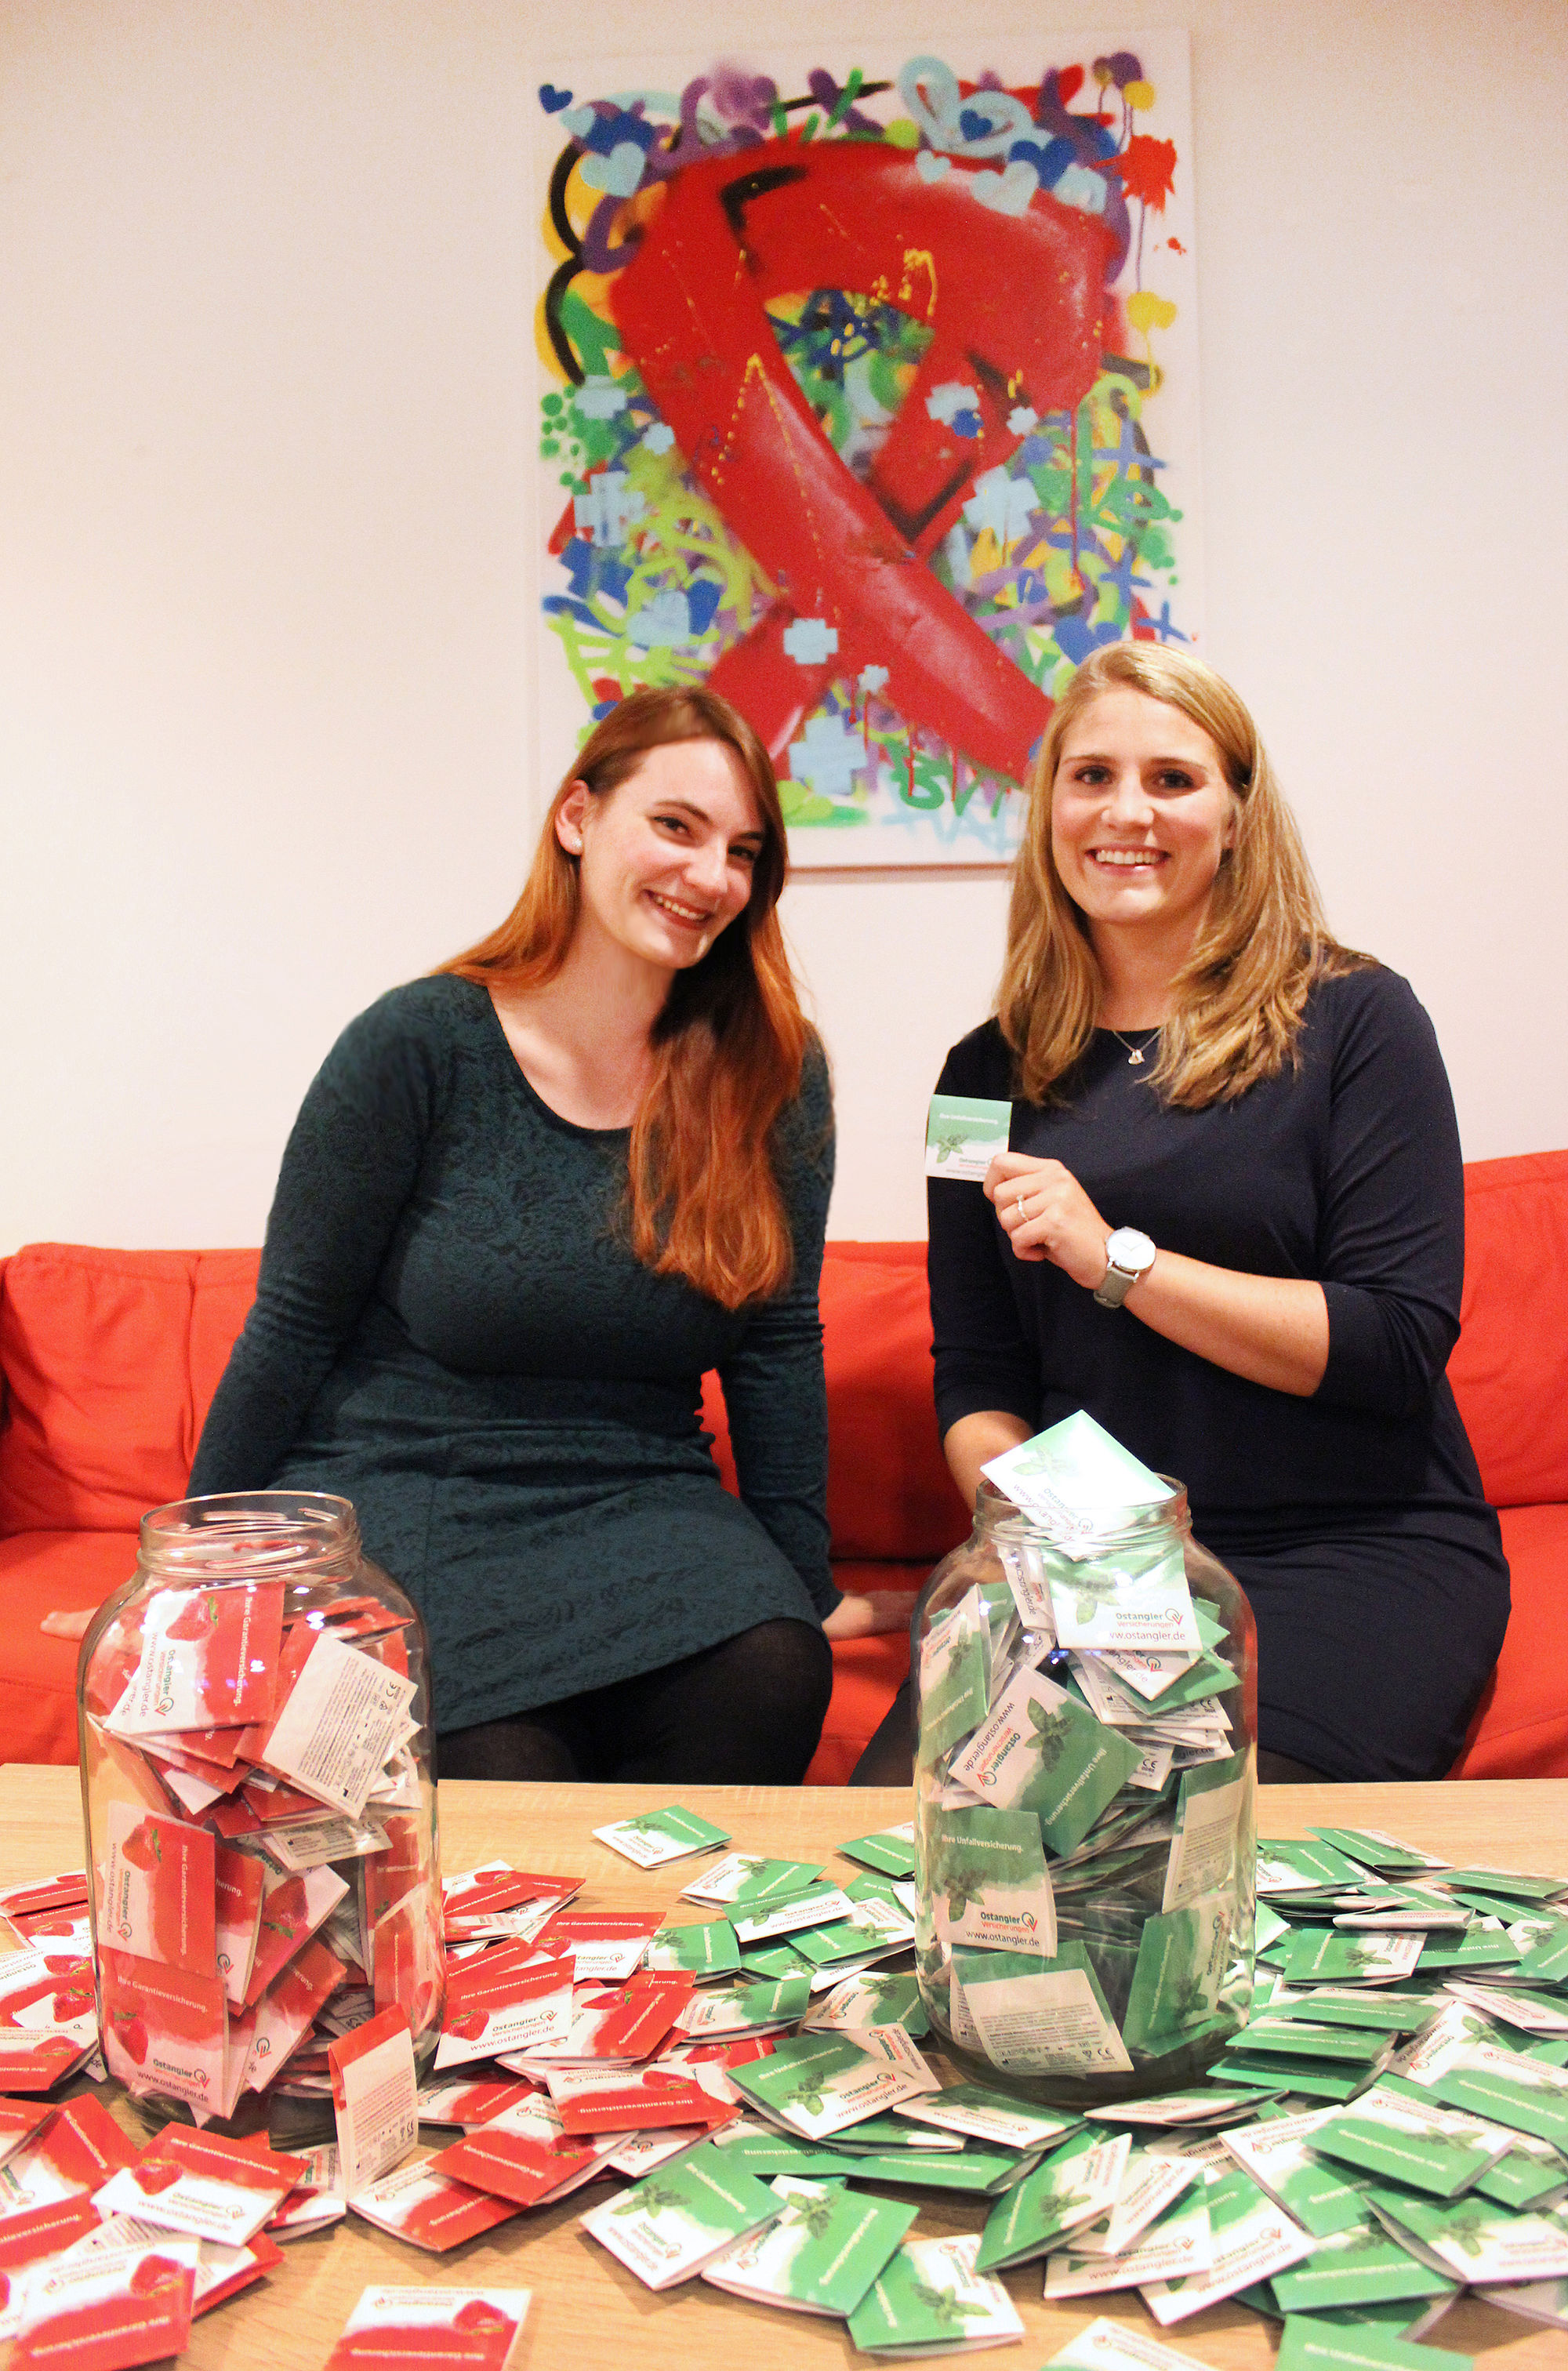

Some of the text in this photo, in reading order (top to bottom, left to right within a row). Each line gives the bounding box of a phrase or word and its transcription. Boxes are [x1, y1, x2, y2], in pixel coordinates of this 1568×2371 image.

[244, 1596, 253, 1616] Ihre
[1116, 1612, 1163, 1621] Ostangler
[965, 1702, 1016, 1771] www.ostangler.de
[991, 1732, 1021, 1773] Ostangler
[1092, 1747, 1108, 1764] Ihre
[942, 1834, 956, 1844] Ihre
[981, 1911, 1021, 1925] Ostangler
[966, 1930, 1040, 1947] www.ostangler.de
[118, 1975, 208, 2013] Ihre Garantieversicherung.
[461, 1971, 559, 2000] Ihre Garantieversicherung.
[492, 2017, 536, 2032] Ostangler
[470, 2025, 555, 2051] www.ostangler.de
[839, 2080, 880, 2101] Ostangler
